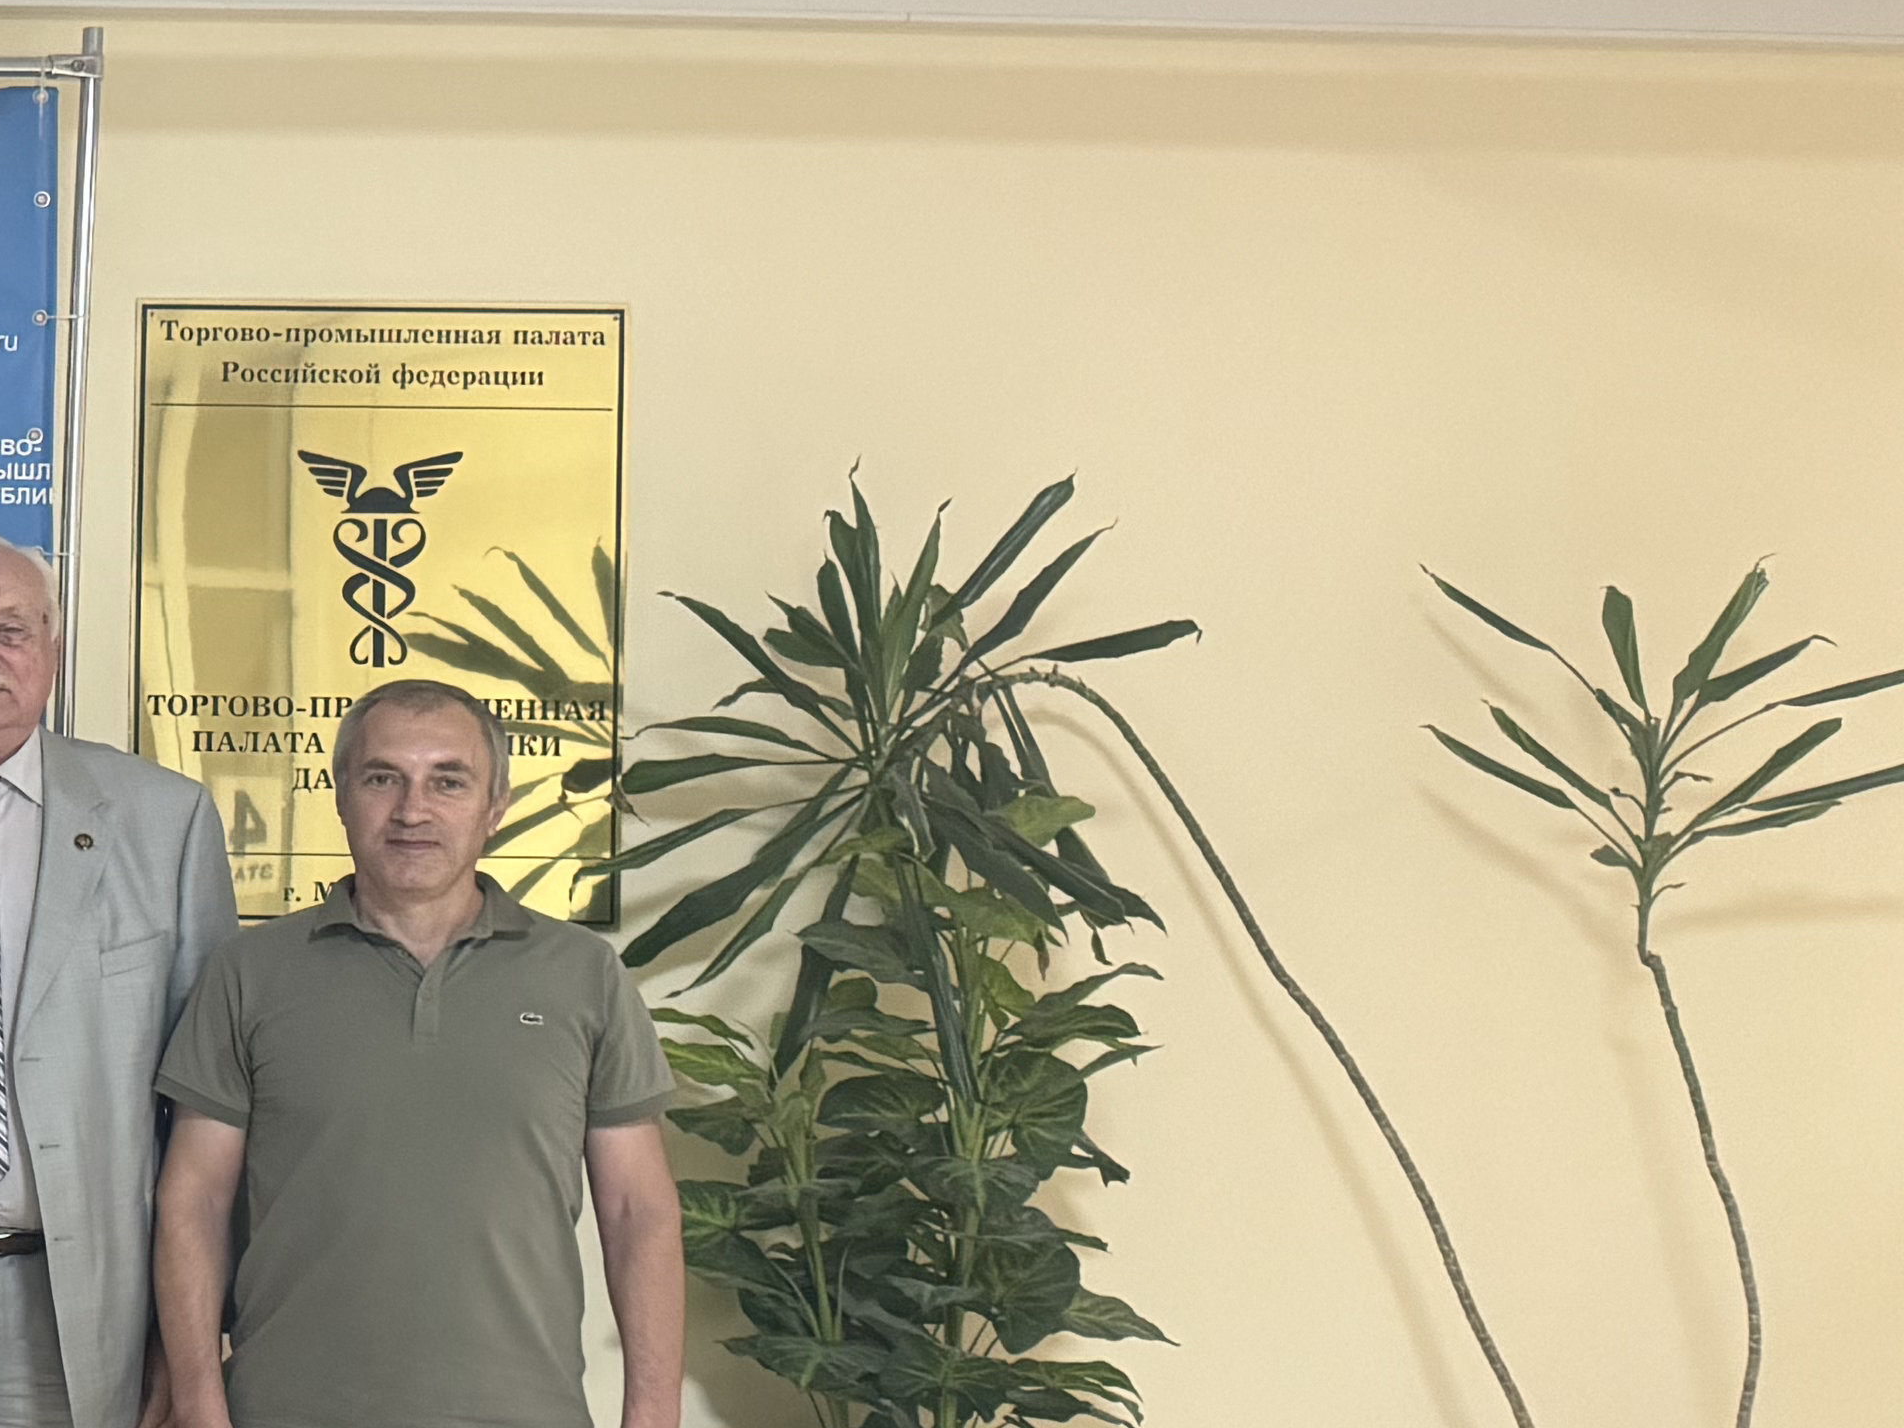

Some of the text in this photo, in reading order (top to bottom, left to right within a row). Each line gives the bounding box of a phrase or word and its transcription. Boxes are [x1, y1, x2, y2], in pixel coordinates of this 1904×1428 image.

[160, 319, 607, 348] Торгово-промышленная палата
[221, 360, 545, 390] Российской федерации
[191, 730, 326, 754] ПАЛАТА
